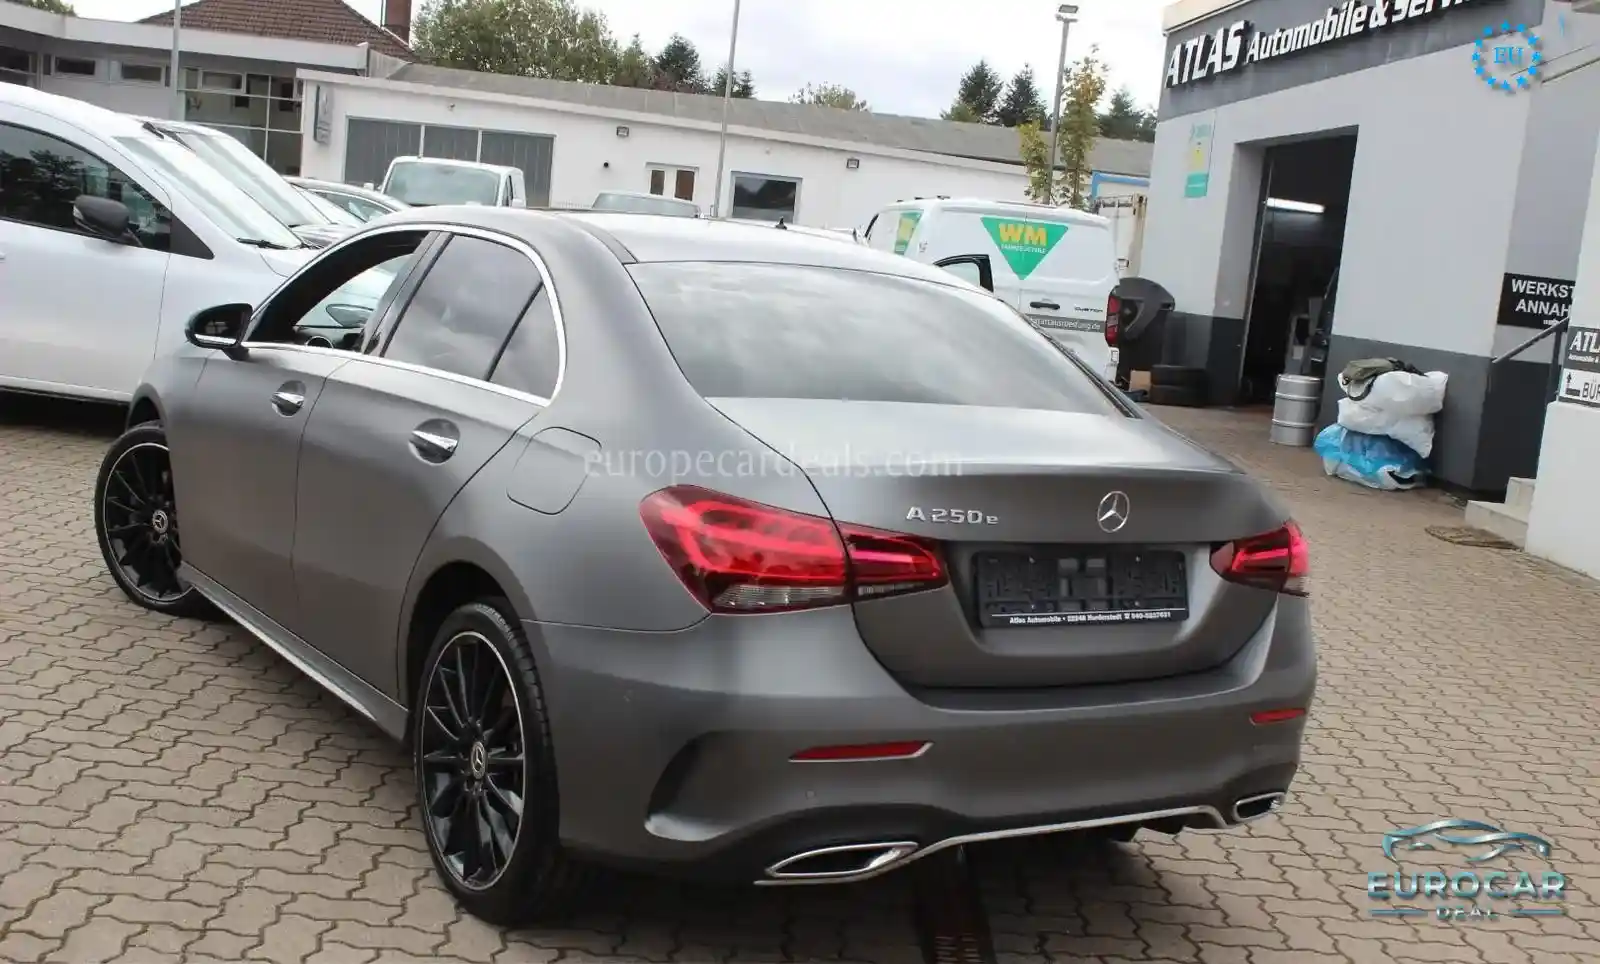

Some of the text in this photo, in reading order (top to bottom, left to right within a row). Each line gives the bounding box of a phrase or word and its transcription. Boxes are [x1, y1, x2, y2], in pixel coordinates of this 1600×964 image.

[1165, 20, 1246, 88] ATLAS
[1246, 1, 1368, 63] Automobile
[998, 223, 1047, 247] WM
[906, 506, 926, 521] A
[1027, 615, 1061, 623] Automobile
